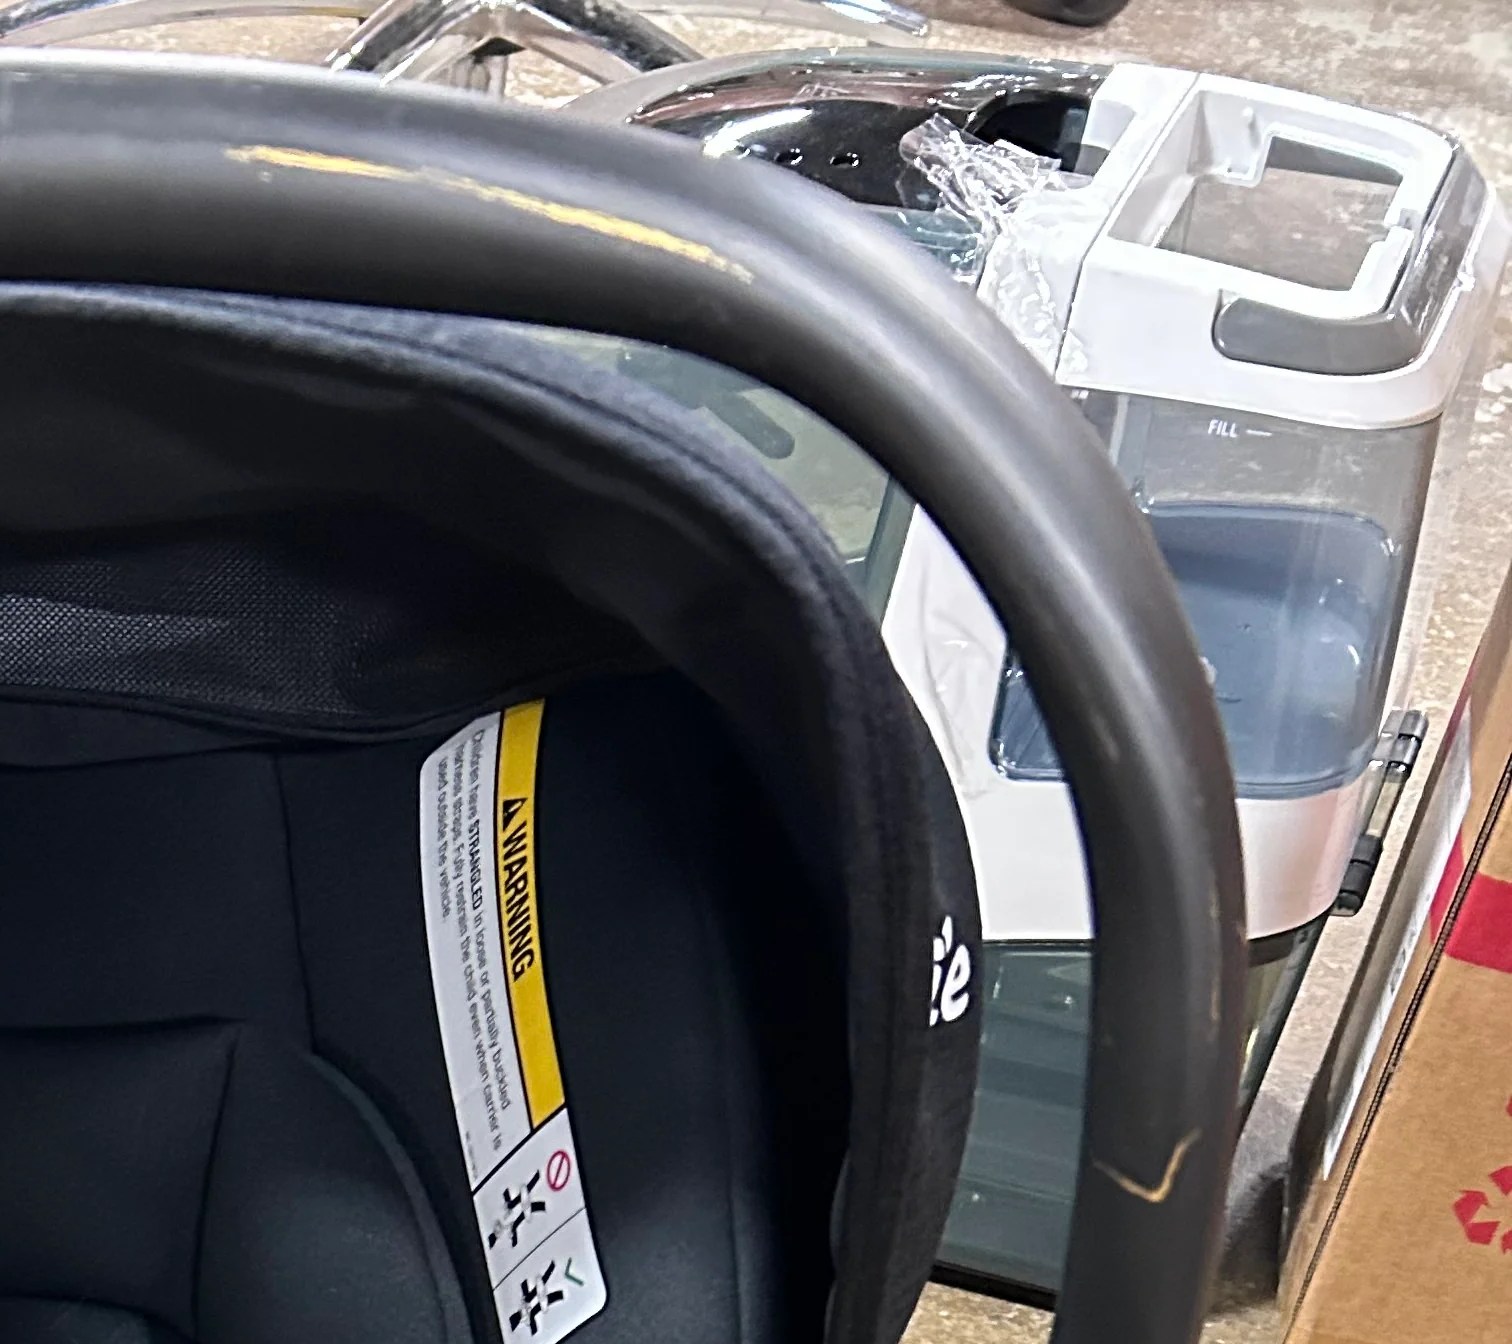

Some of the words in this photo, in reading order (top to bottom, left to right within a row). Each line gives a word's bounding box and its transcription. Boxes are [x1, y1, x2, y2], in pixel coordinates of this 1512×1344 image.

[1208, 419, 1237, 437] FILL
[469, 728, 487, 784] Children
[437, 839, 449, 868] the
[451, 841, 465, 880] Fully
[468, 818, 484, 911] STRANGLED
[501, 817, 534, 982] WARNING
[460, 935, 472, 963] the
[475, 927, 488, 970] loose
[463, 963, 478, 1002] child
[469, 1001, 483, 1040] even
[481, 988, 500, 1049] partially
[475, 1039, 489, 1083] when
[492, 1047, 512, 1111] buckled
[483, 1082, 500, 1133] carrier
